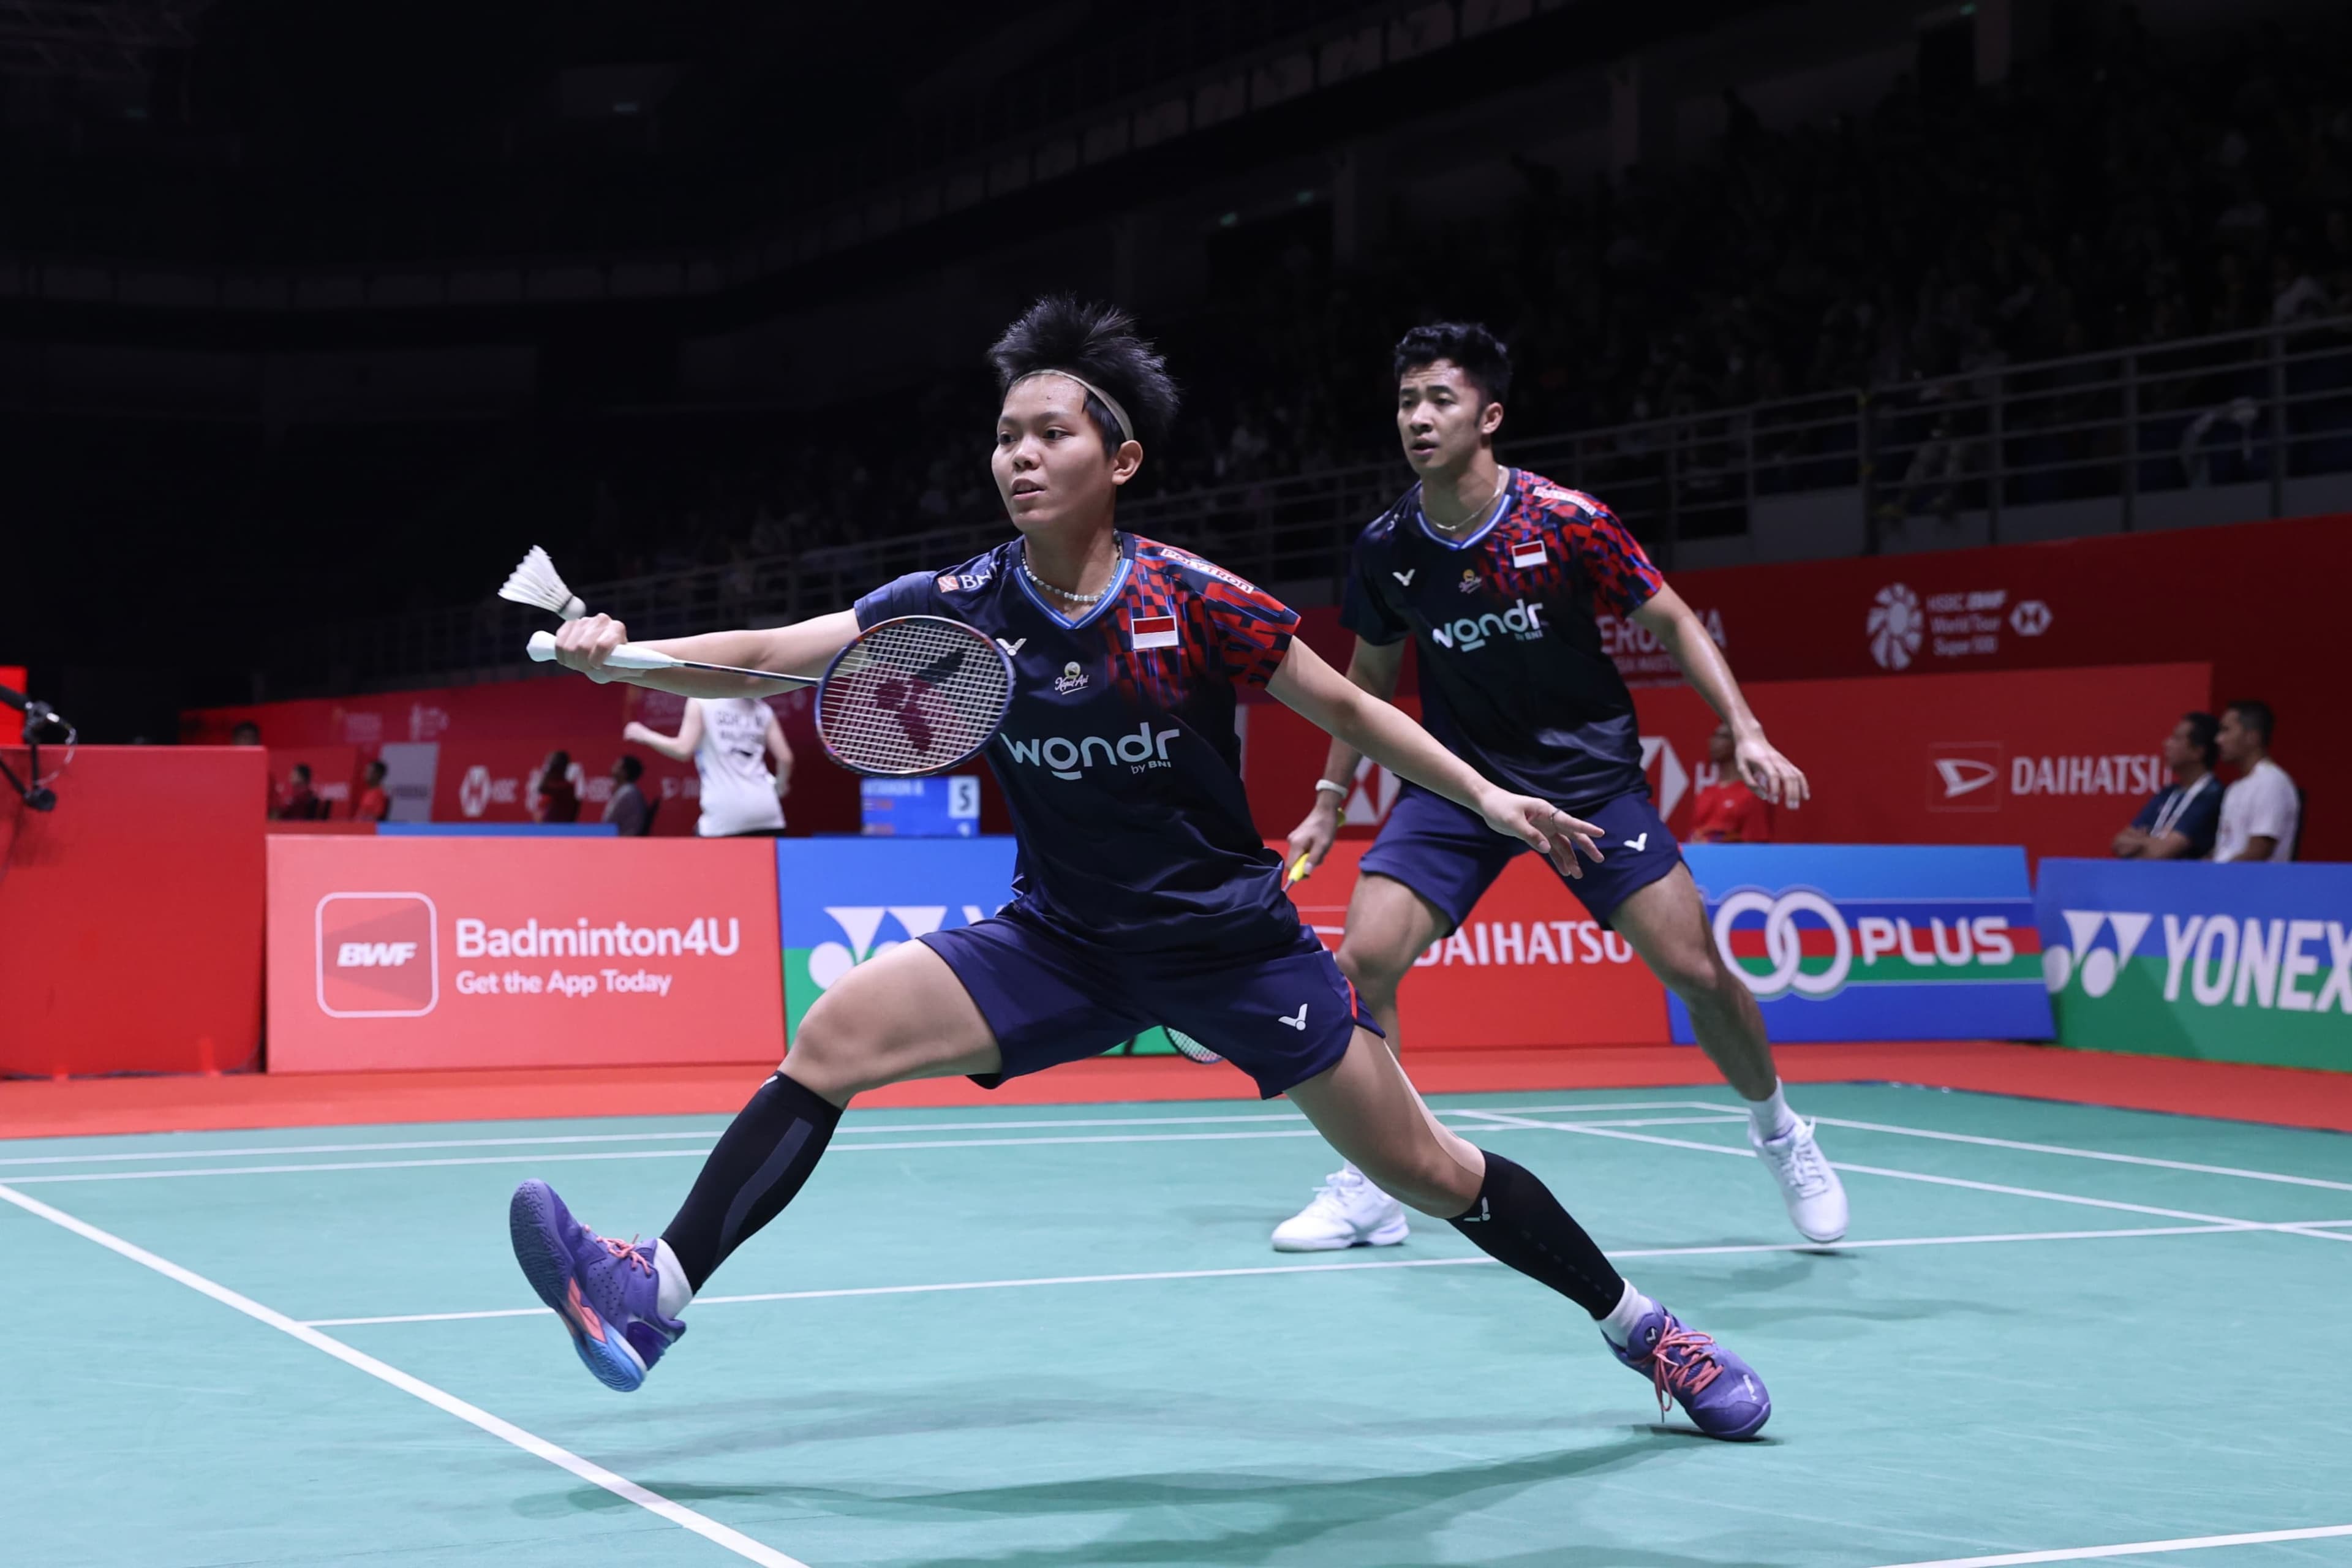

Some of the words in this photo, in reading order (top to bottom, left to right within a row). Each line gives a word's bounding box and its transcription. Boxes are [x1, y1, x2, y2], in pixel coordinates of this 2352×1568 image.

[1000, 722, 1180, 780] wondr
[1131, 765, 1145, 774] by
[337, 943, 417, 967] BWF
[456, 918, 740, 957] Badminton4U
[1859, 916, 2015, 967] PLUS
[456, 971, 499, 994] Get
[503, 970, 542, 993] the
[547, 971, 597, 997] App
[601, 969, 672, 997] Today
[2163, 914, 2352, 1015] YONEX
